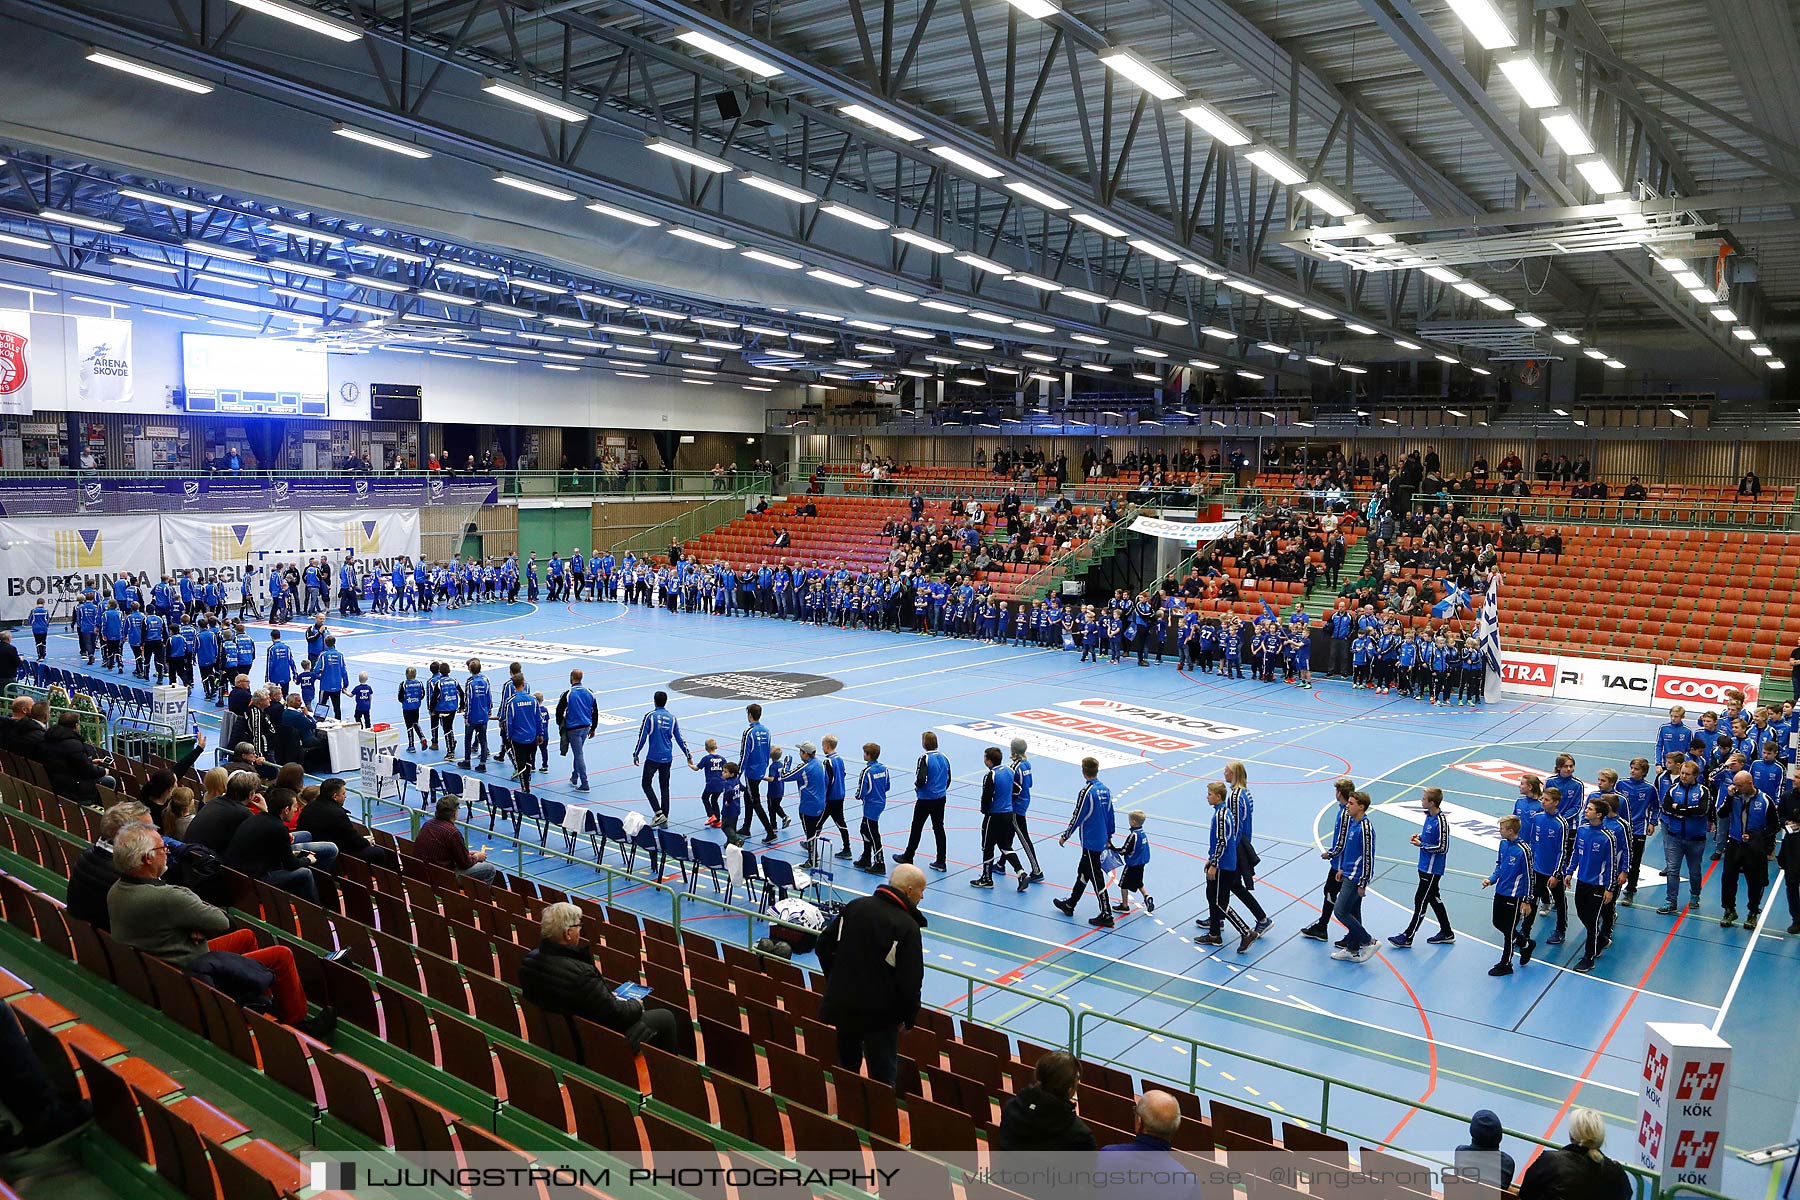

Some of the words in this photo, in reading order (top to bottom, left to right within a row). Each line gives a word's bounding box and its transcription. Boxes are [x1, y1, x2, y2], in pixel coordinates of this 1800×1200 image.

[94, 358, 128, 368] ARENA
[371, 386, 377, 394] H
[416, 388, 422, 397] G
[1201, 629, 1212, 640] 27
[153, 701, 164, 714] EY
[167, 701, 186, 714] EY
[1114, 707, 1240, 734] PAROC
[1024, 711, 1182, 748] GRAMO
[361, 746, 374, 762] EY
[1646, 1086, 1660, 1108] KÖK
[1683, 1103, 1712, 1117] KÖK
[1678, 1171, 1707, 1185] KÖK
